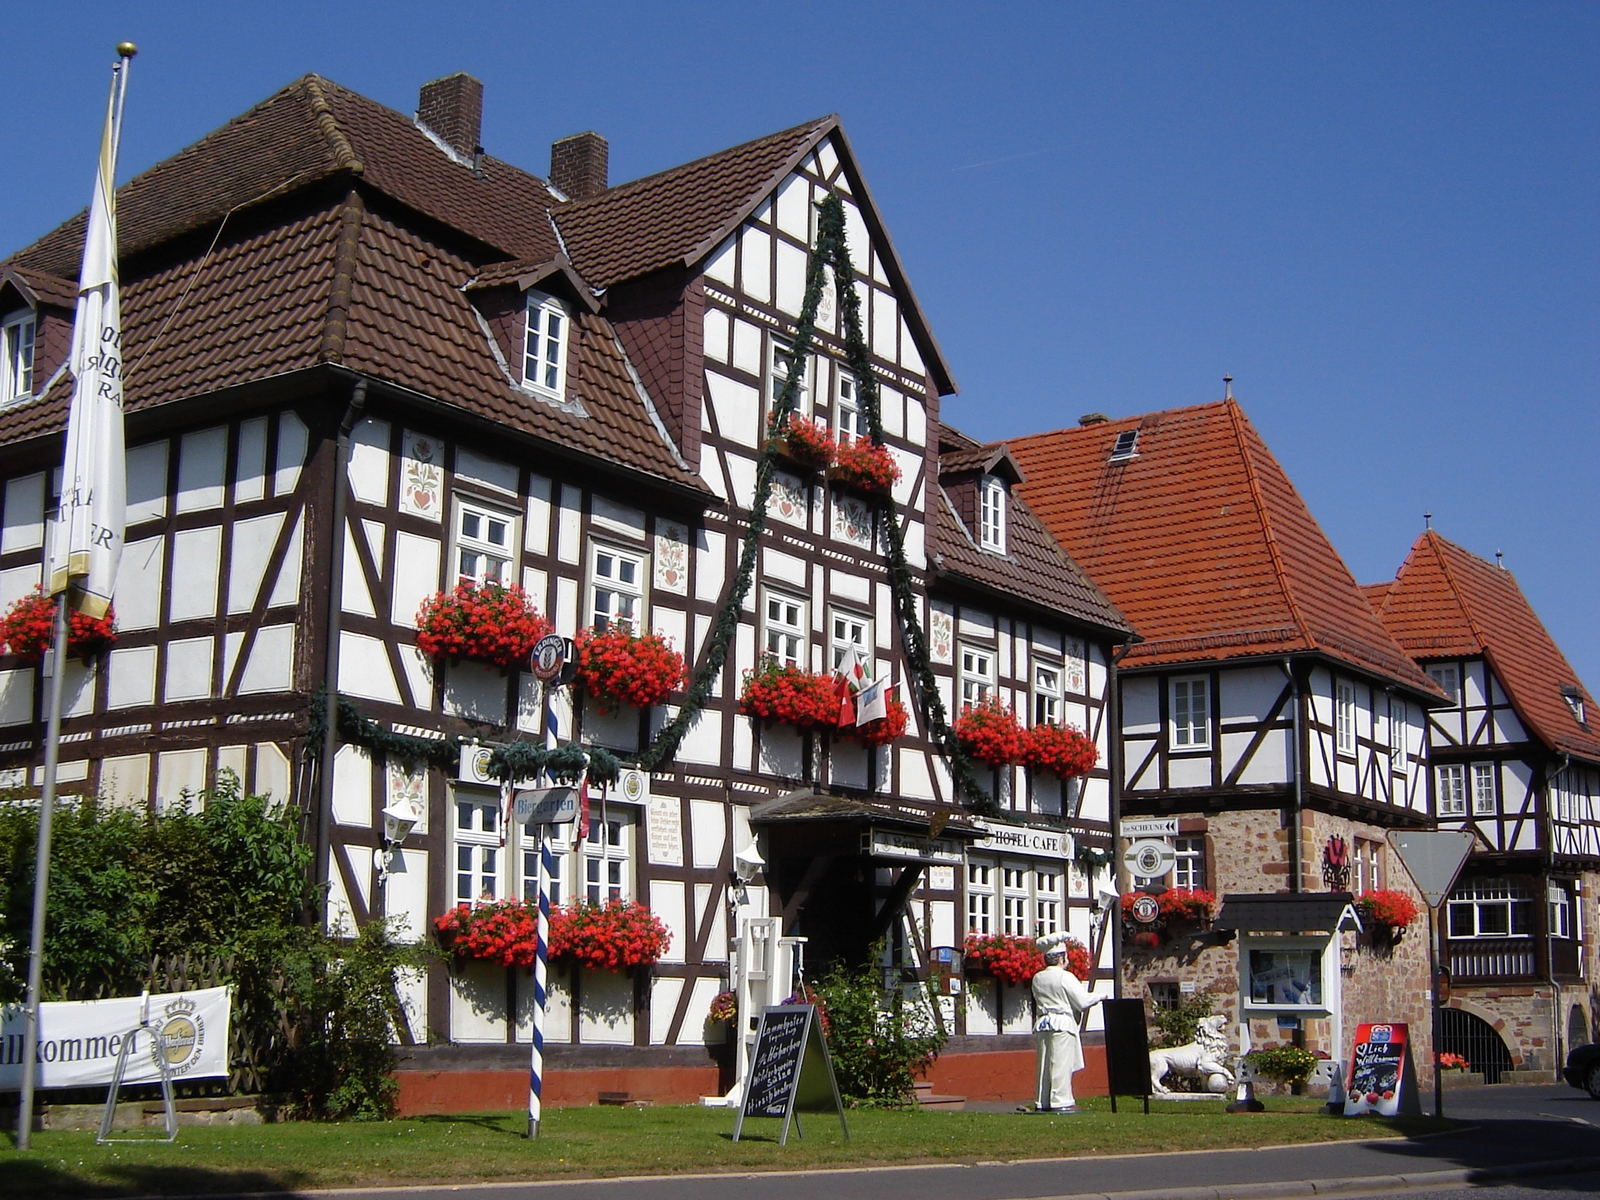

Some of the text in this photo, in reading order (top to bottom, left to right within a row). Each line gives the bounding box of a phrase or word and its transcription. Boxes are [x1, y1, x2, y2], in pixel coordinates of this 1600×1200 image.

[535, 637, 562, 656] ERDINGER
[517, 799, 574, 816] Biergarten
[1130, 824, 1165, 832] SCHEUNE
[995, 830, 1030, 848] HOTEL
[762, 1014, 804, 1037] Lammbraten
[0, 1033, 137, 1065] illkommen
